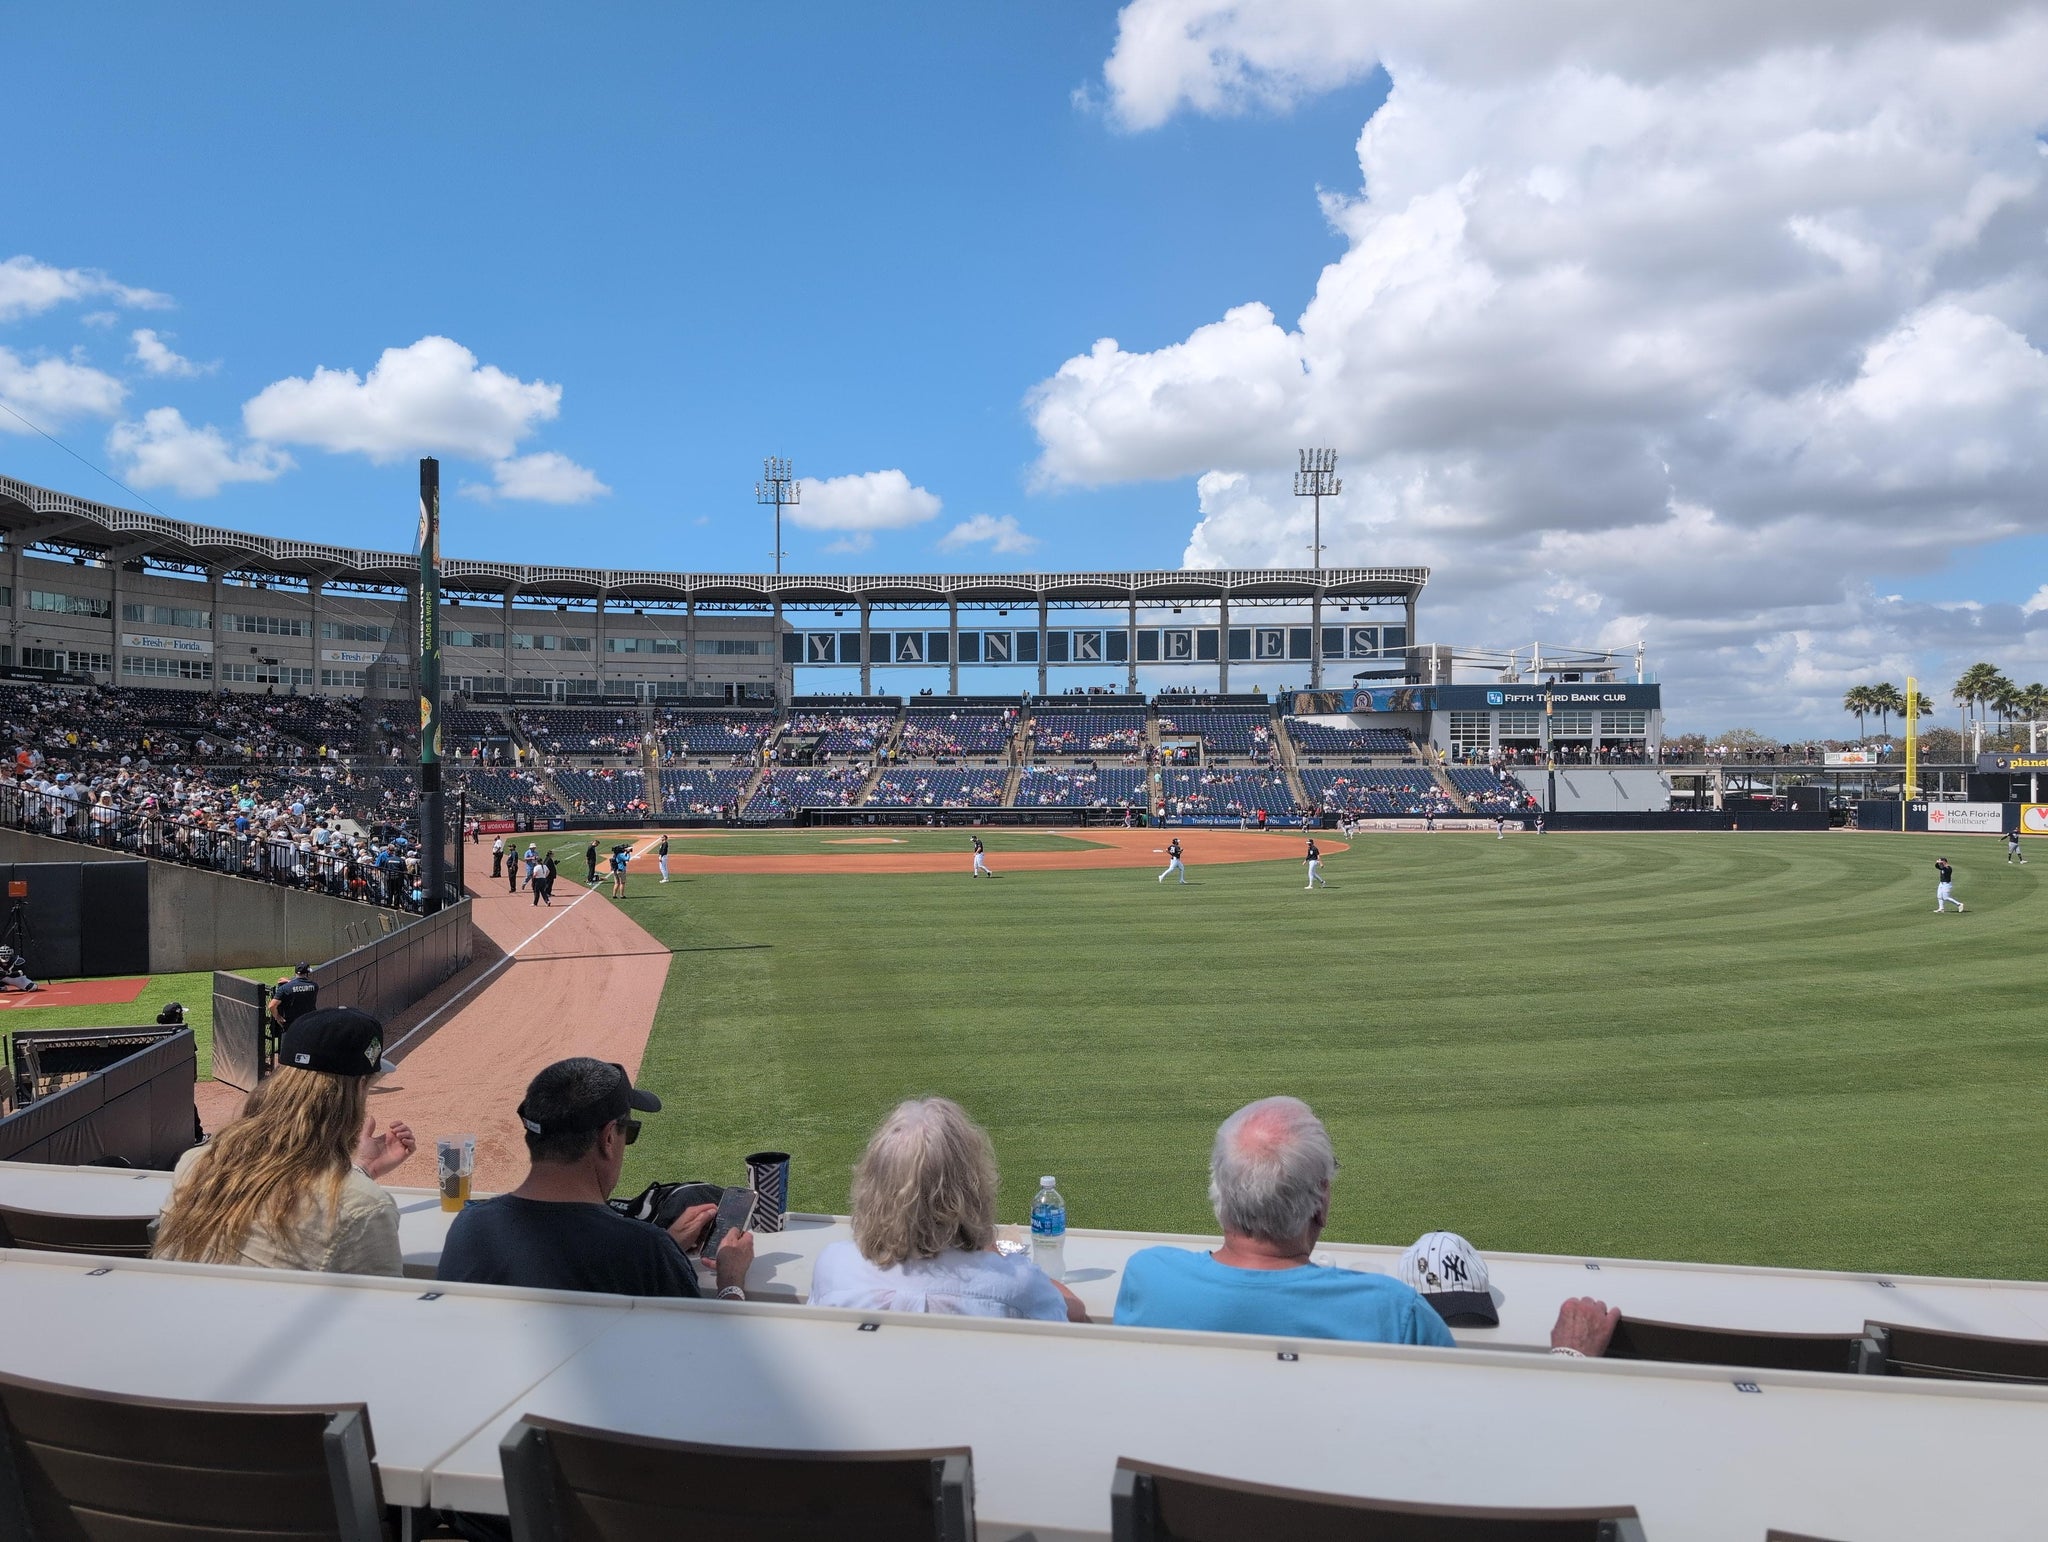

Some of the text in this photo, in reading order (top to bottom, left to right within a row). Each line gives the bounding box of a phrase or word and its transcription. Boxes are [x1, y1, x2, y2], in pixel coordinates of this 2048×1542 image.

[142, 637, 163, 648] Fresh
[174, 640, 200, 650] Florida
[811, 632, 1372, 661] YANKEES
[341, 652, 361, 661] Fresh
[1505, 694, 1534, 702] FIFTH
[1571, 694, 1600, 702] BANK
[1603, 694, 1627, 702] CLUB
[1912, 804, 1927, 812] 318
[1948, 810, 2001, 818] HCA Florida
[1948, 817, 1988, 825] Healthcare
[1737, 1383, 1758, 1391] 10
